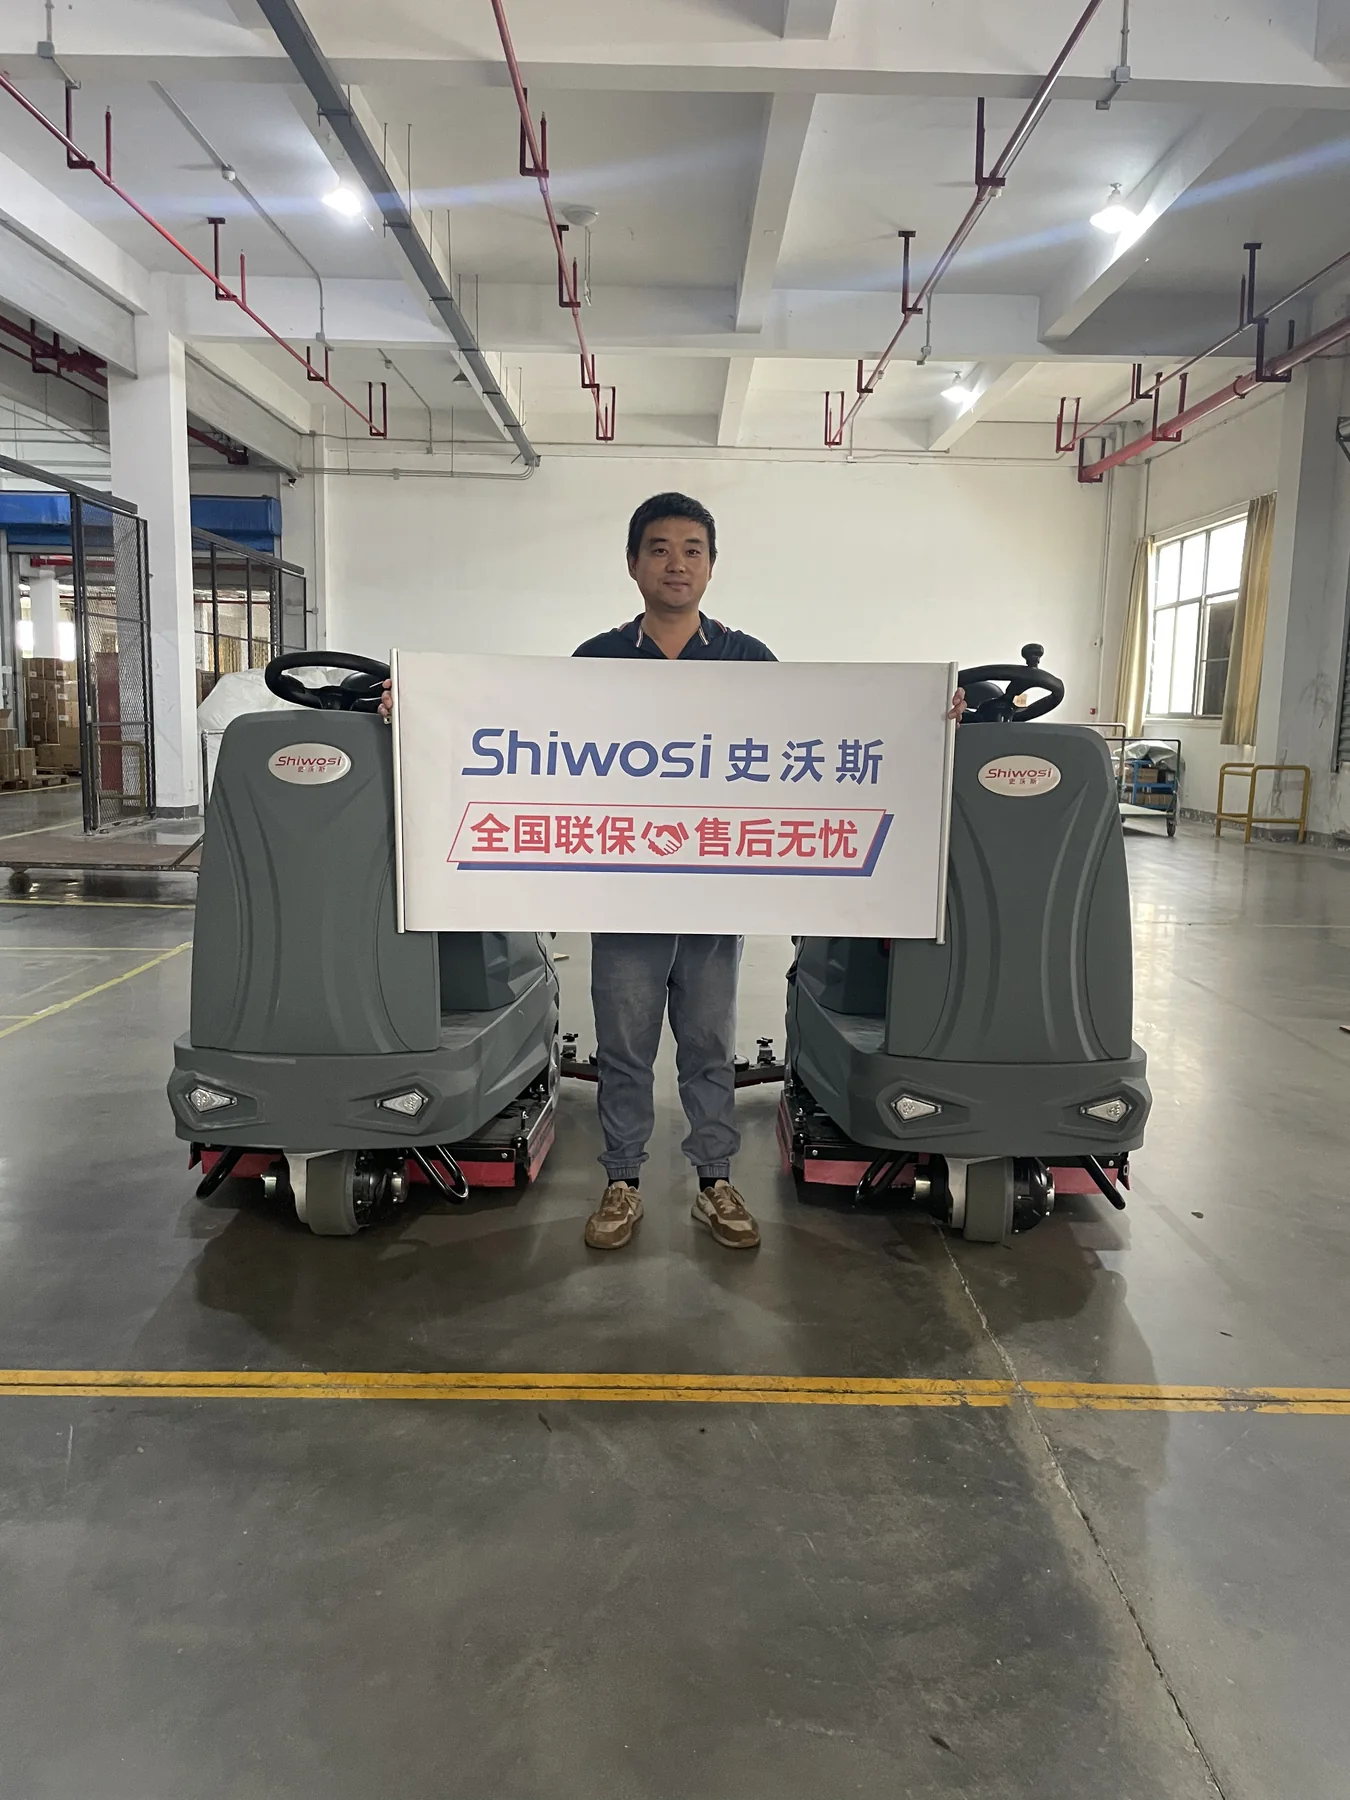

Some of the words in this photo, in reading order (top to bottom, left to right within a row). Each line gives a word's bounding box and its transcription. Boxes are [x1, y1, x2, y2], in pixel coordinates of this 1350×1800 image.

[275, 756, 342, 766] Shiwosi
[461, 728, 712, 779] Shiwosi
[725, 737, 884, 785] 史沃斯
[985, 768, 1052, 778] Shiwosi
[469, 812, 636, 856] 全国联保
[694, 816, 858, 859] 售后无忧
